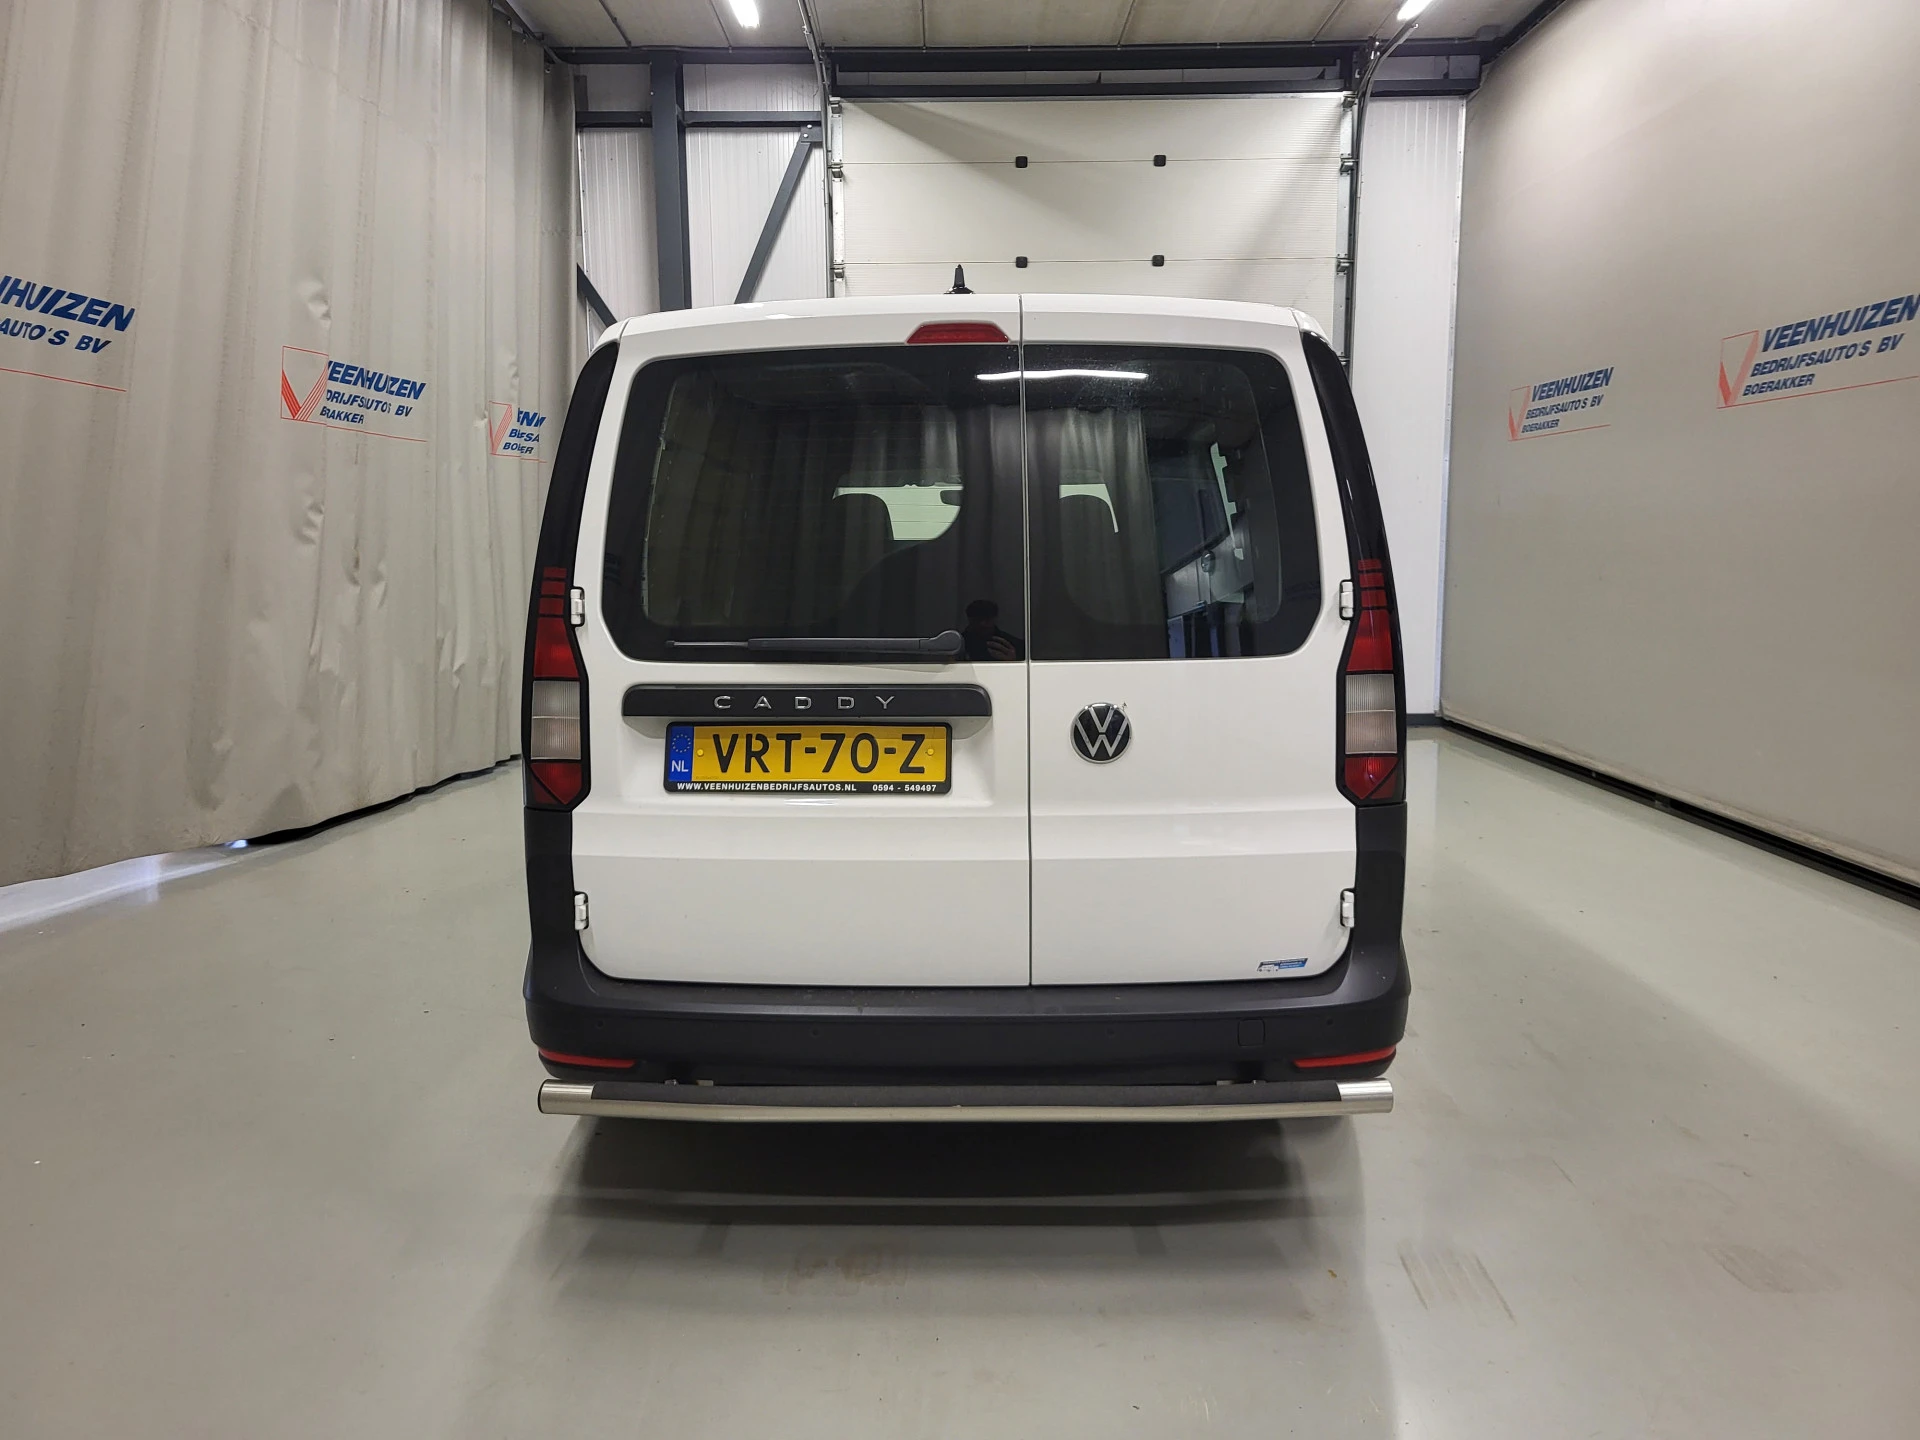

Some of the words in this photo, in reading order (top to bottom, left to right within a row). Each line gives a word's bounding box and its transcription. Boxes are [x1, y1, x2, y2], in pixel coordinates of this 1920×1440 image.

[1761, 293, 1920, 352] VEENHUIZEN
[74, 335, 112, 354] BV
[1750, 340, 1872, 377] BEDRIJFSAUTO'S
[1876, 333, 1905, 353] BV
[1531, 366, 1615, 402] VEENHUIZEN
[1742, 373, 1815, 396] BOERAKKER
[395, 404, 413, 417] BV
[1525, 397, 1589, 420] BEDRIJFSAUTO'S
[1590, 394, 1605, 408] BV
[1521, 418, 1560, 433] BOERAKKER
[713, 695, 895, 710] CADDY
[712, 733, 926, 774] VRT-70-Z
[671, 759, 689, 773] NL
[677, 782, 857, 792] WWW.VEENHUIZENBEDRIJFSAUTOS.NL
[872, 784, 895, 792] 0594
[904, 784, 937, 792] 549497
